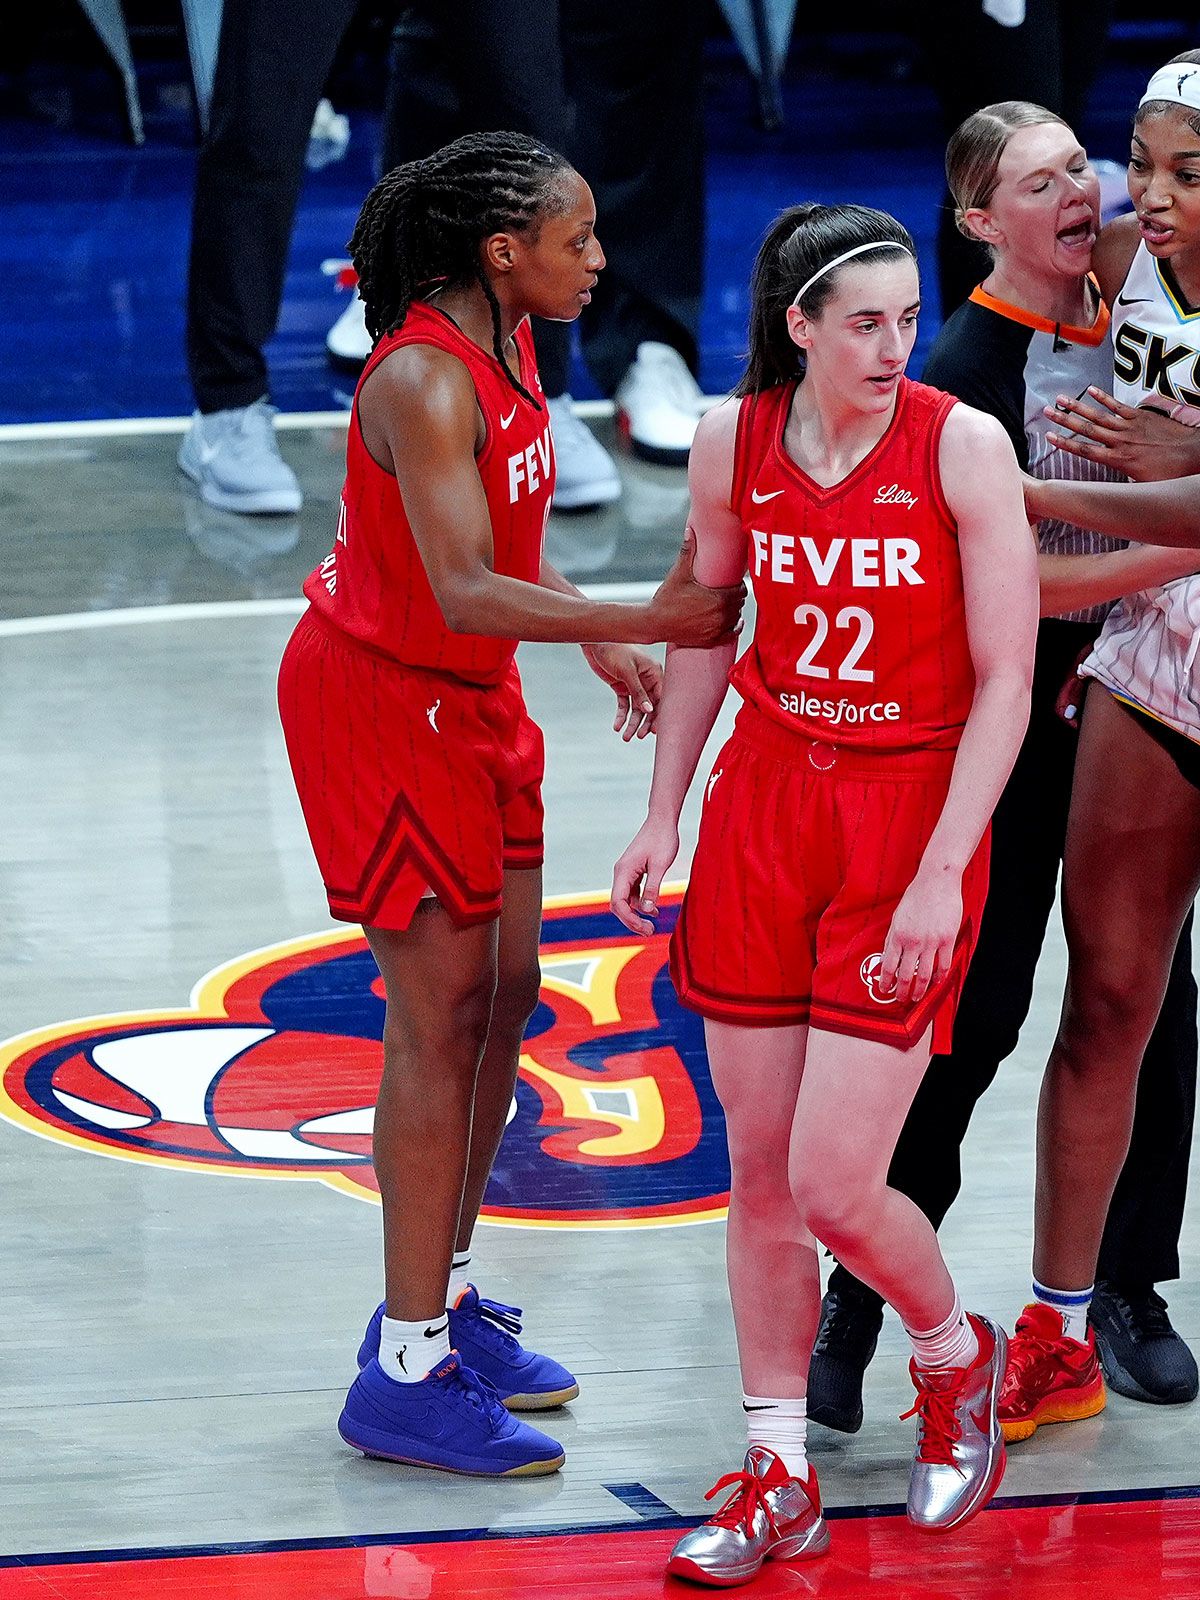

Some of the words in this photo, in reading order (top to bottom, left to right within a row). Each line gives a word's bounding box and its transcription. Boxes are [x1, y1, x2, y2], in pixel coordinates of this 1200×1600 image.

[508, 426, 550, 504] FEV
[873, 483, 919, 509] Lilly
[751, 529, 925, 587] FEVER
[794, 603, 874, 682] 22
[779, 691, 900, 724] salesforce
